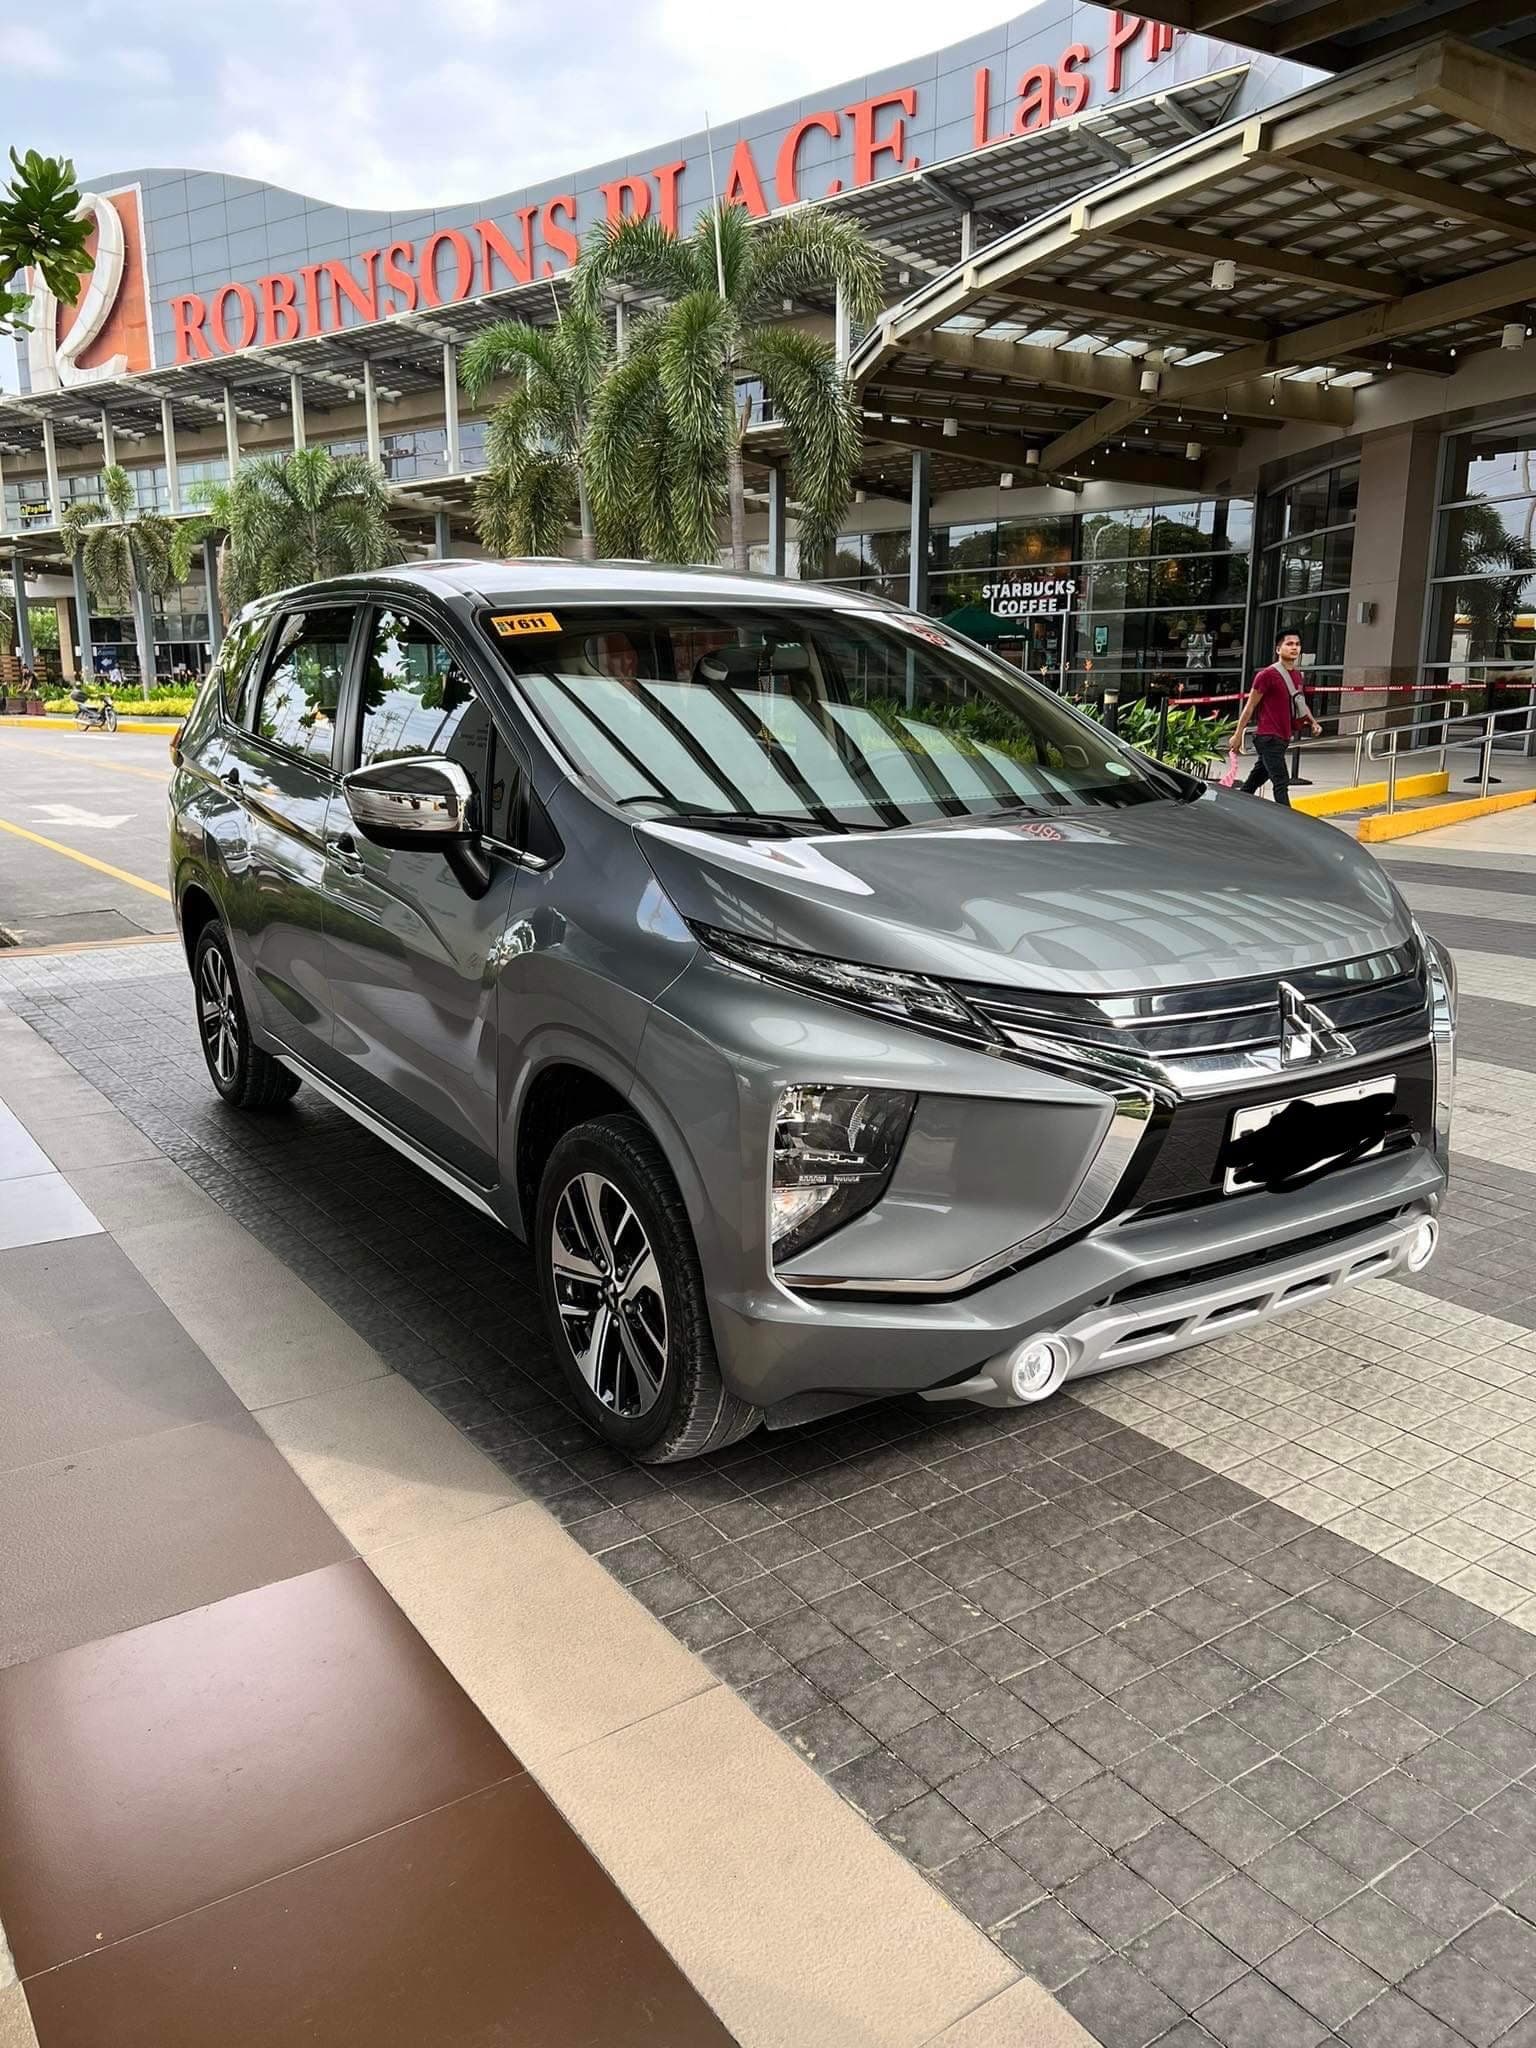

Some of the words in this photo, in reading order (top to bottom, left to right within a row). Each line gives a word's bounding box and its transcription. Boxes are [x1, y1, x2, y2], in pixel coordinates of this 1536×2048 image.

[169, 195, 580, 364] ROBINSONS
[974, 43, 1090, 149] Las
[982, 580, 1076, 599] STARBUCKS
[998, 599, 1058, 614] COFFEE
